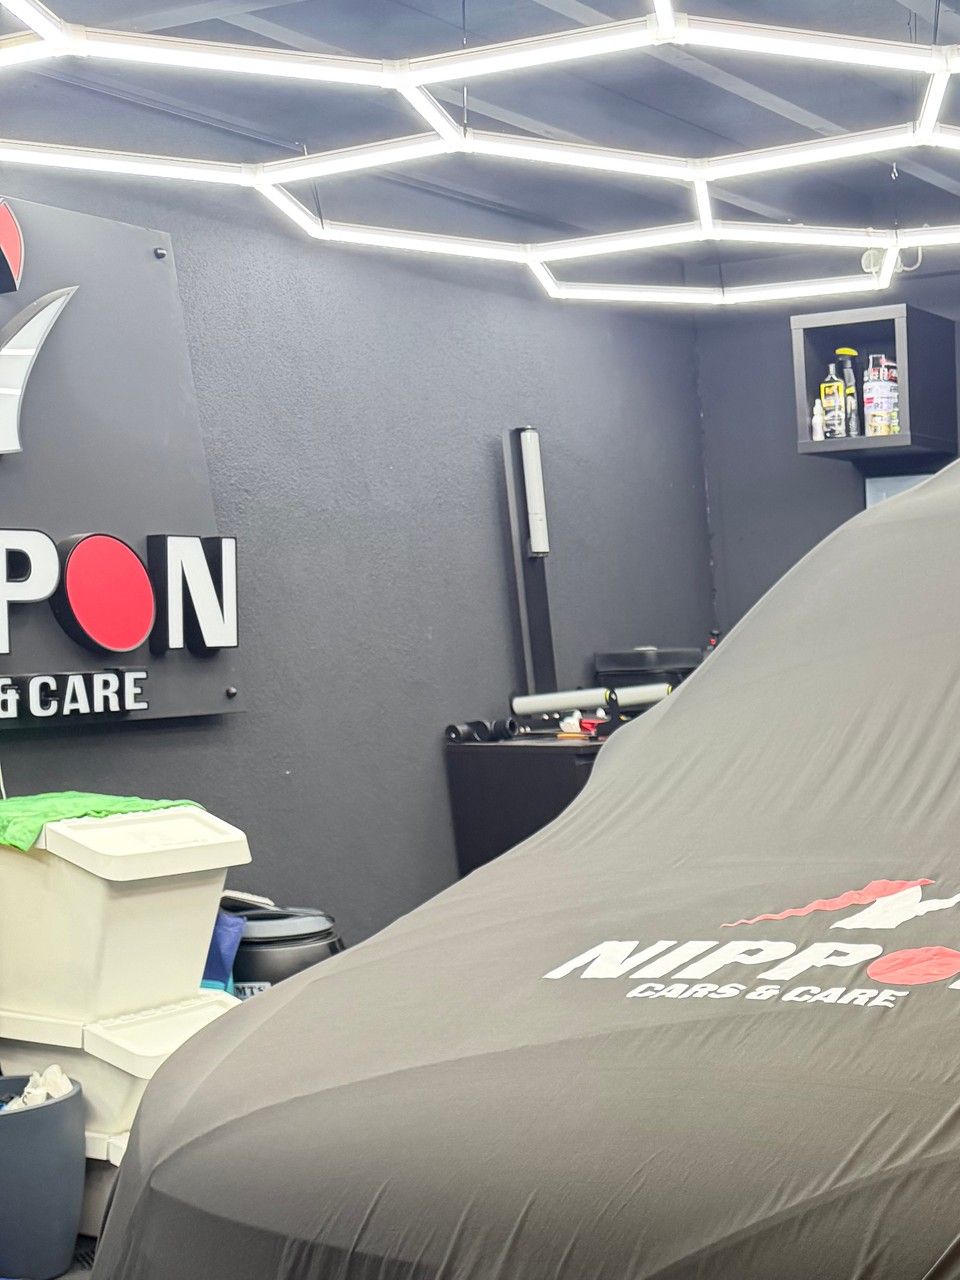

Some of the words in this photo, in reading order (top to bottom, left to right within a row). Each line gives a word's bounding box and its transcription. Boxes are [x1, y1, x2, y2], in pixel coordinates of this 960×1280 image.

[28, 671, 149, 717] CARE
[626, 982, 747, 999] CARS
[745, 984, 777, 1001] &
[781, 985, 909, 1009] CARE
